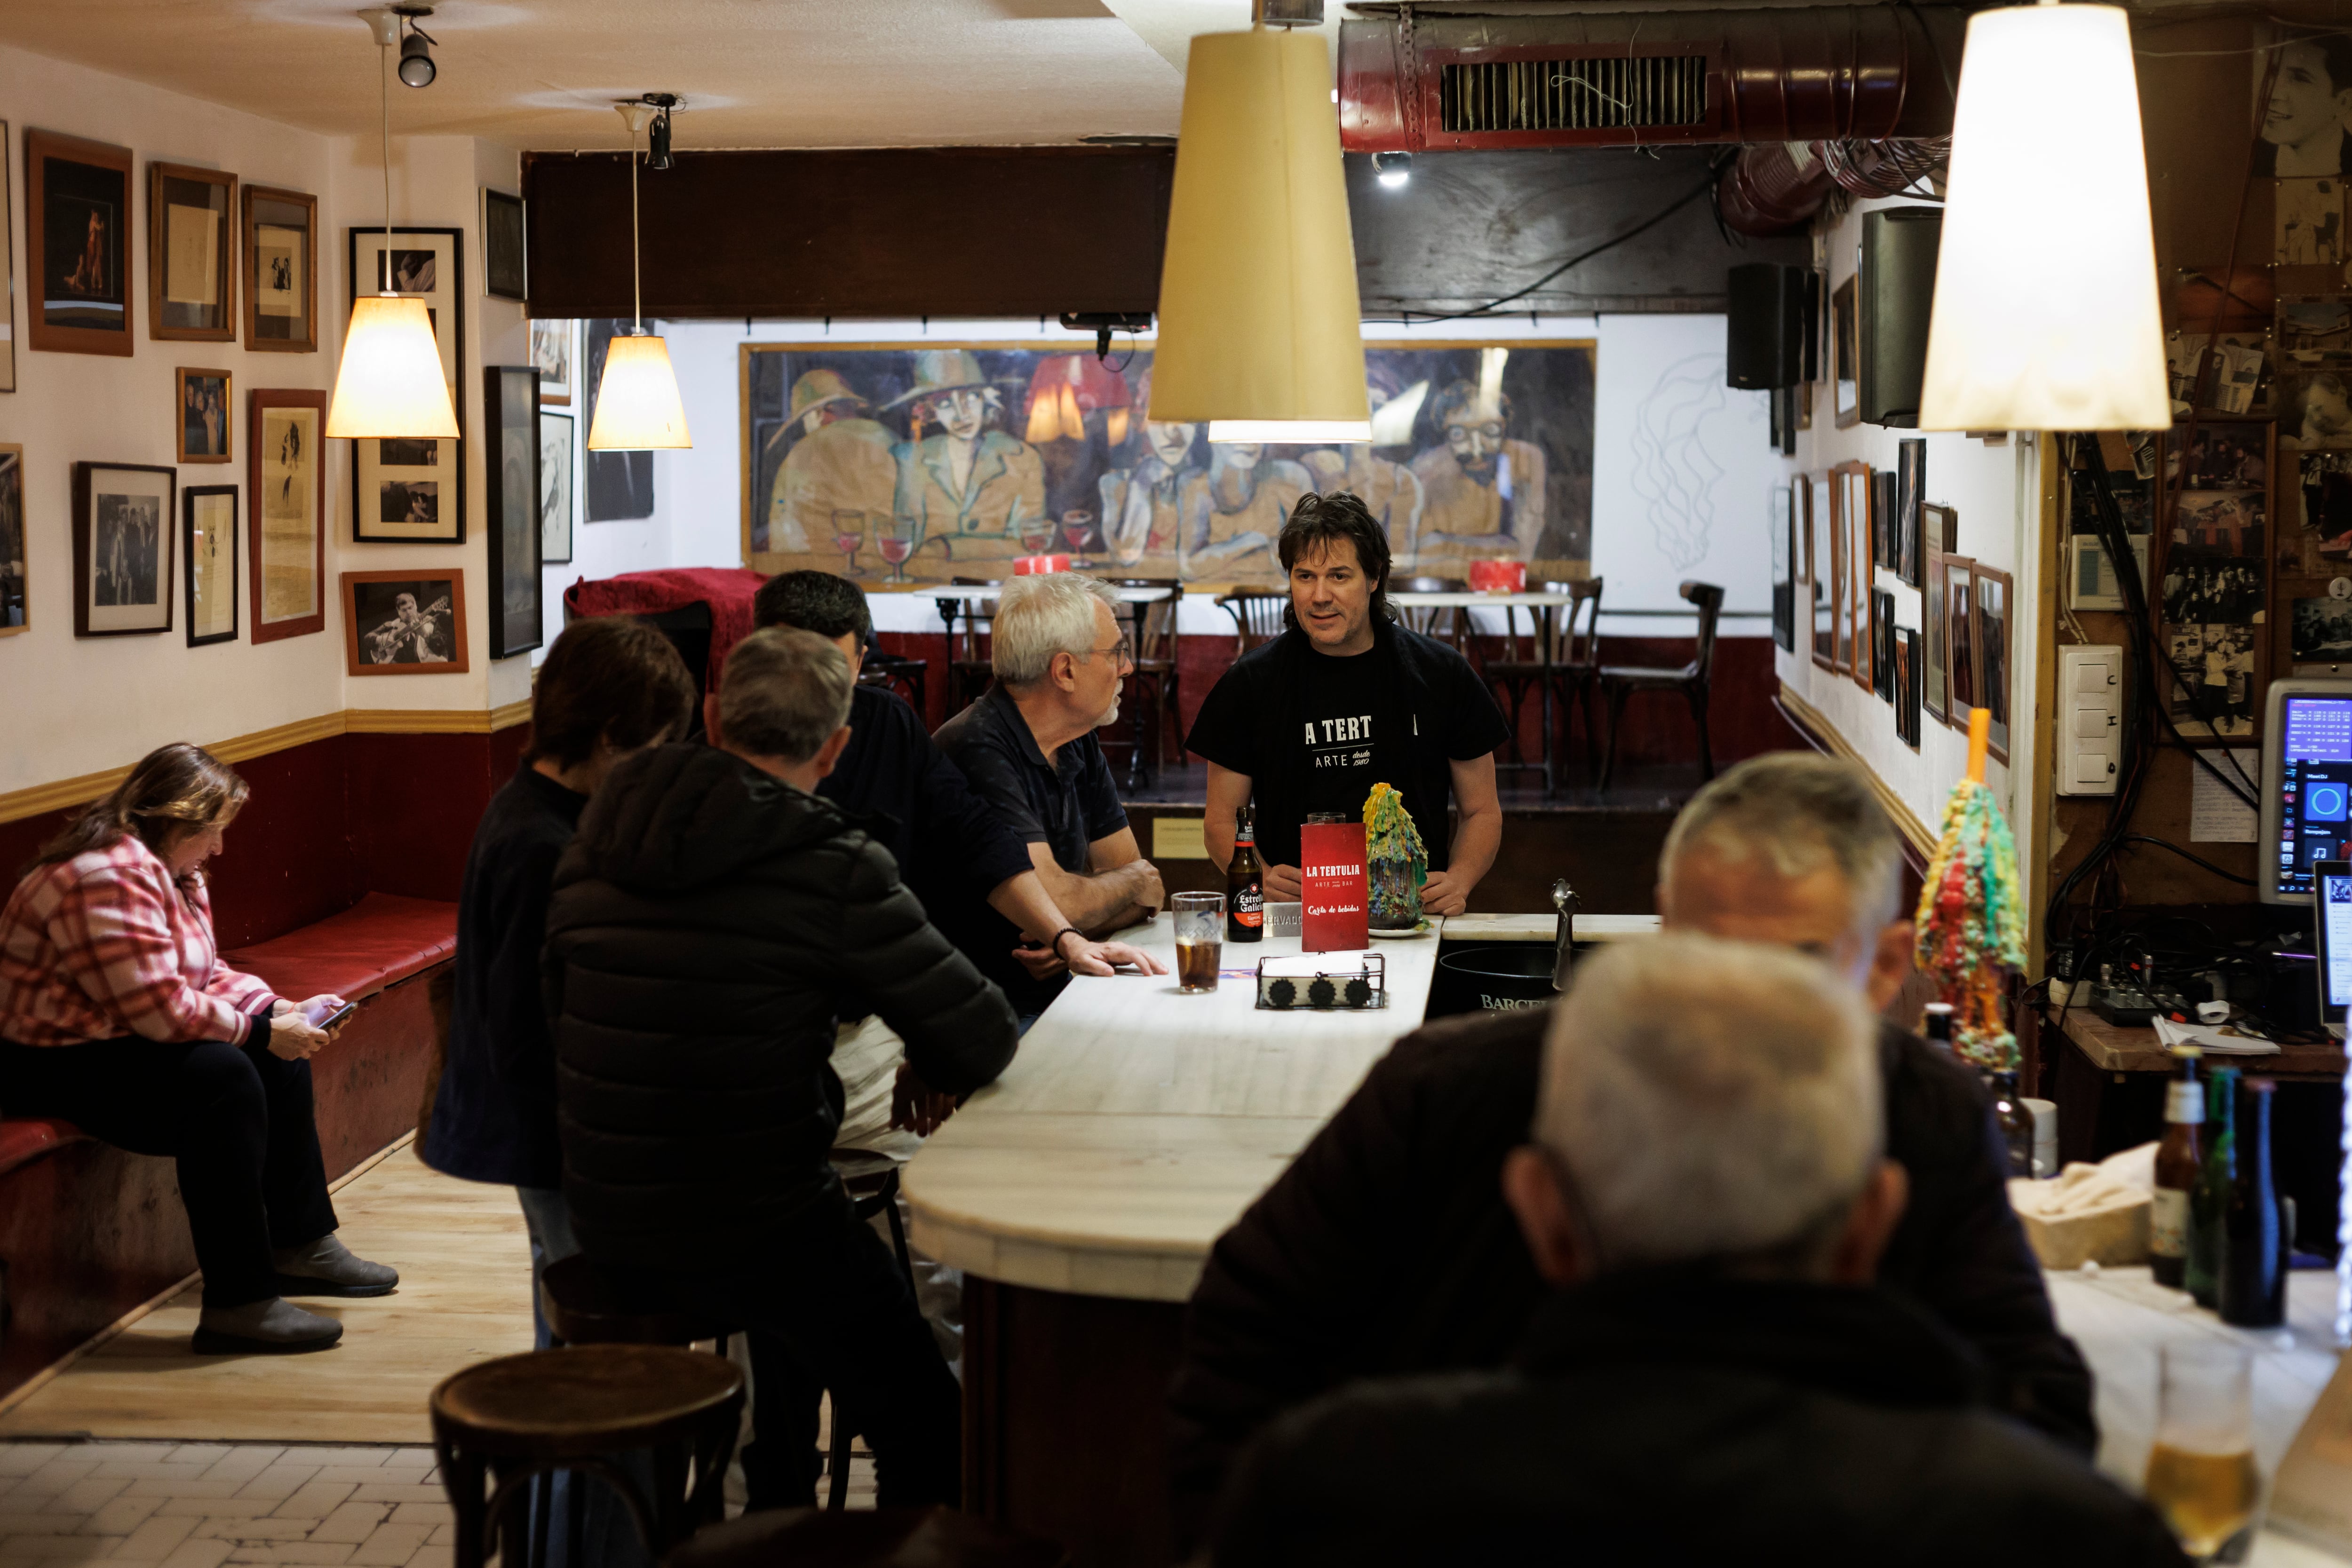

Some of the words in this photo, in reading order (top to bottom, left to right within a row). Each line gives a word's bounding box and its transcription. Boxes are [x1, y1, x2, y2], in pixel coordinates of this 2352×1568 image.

[1305, 722, 1316, 744] A
[1322, 715, 1371, 742] TERT
[1352, 750, 1370, 759] desde
[1316, 754, 1347, 768] ARTE
[1353, 758, 1369, 767] 1980
[1306, 866, 1317, 877] LA
[1320, 864, 1359, 876] TERTULIA
[1308, 905, 1326, 916] Carta
[1337, 904, 1359, 913] bebidas
